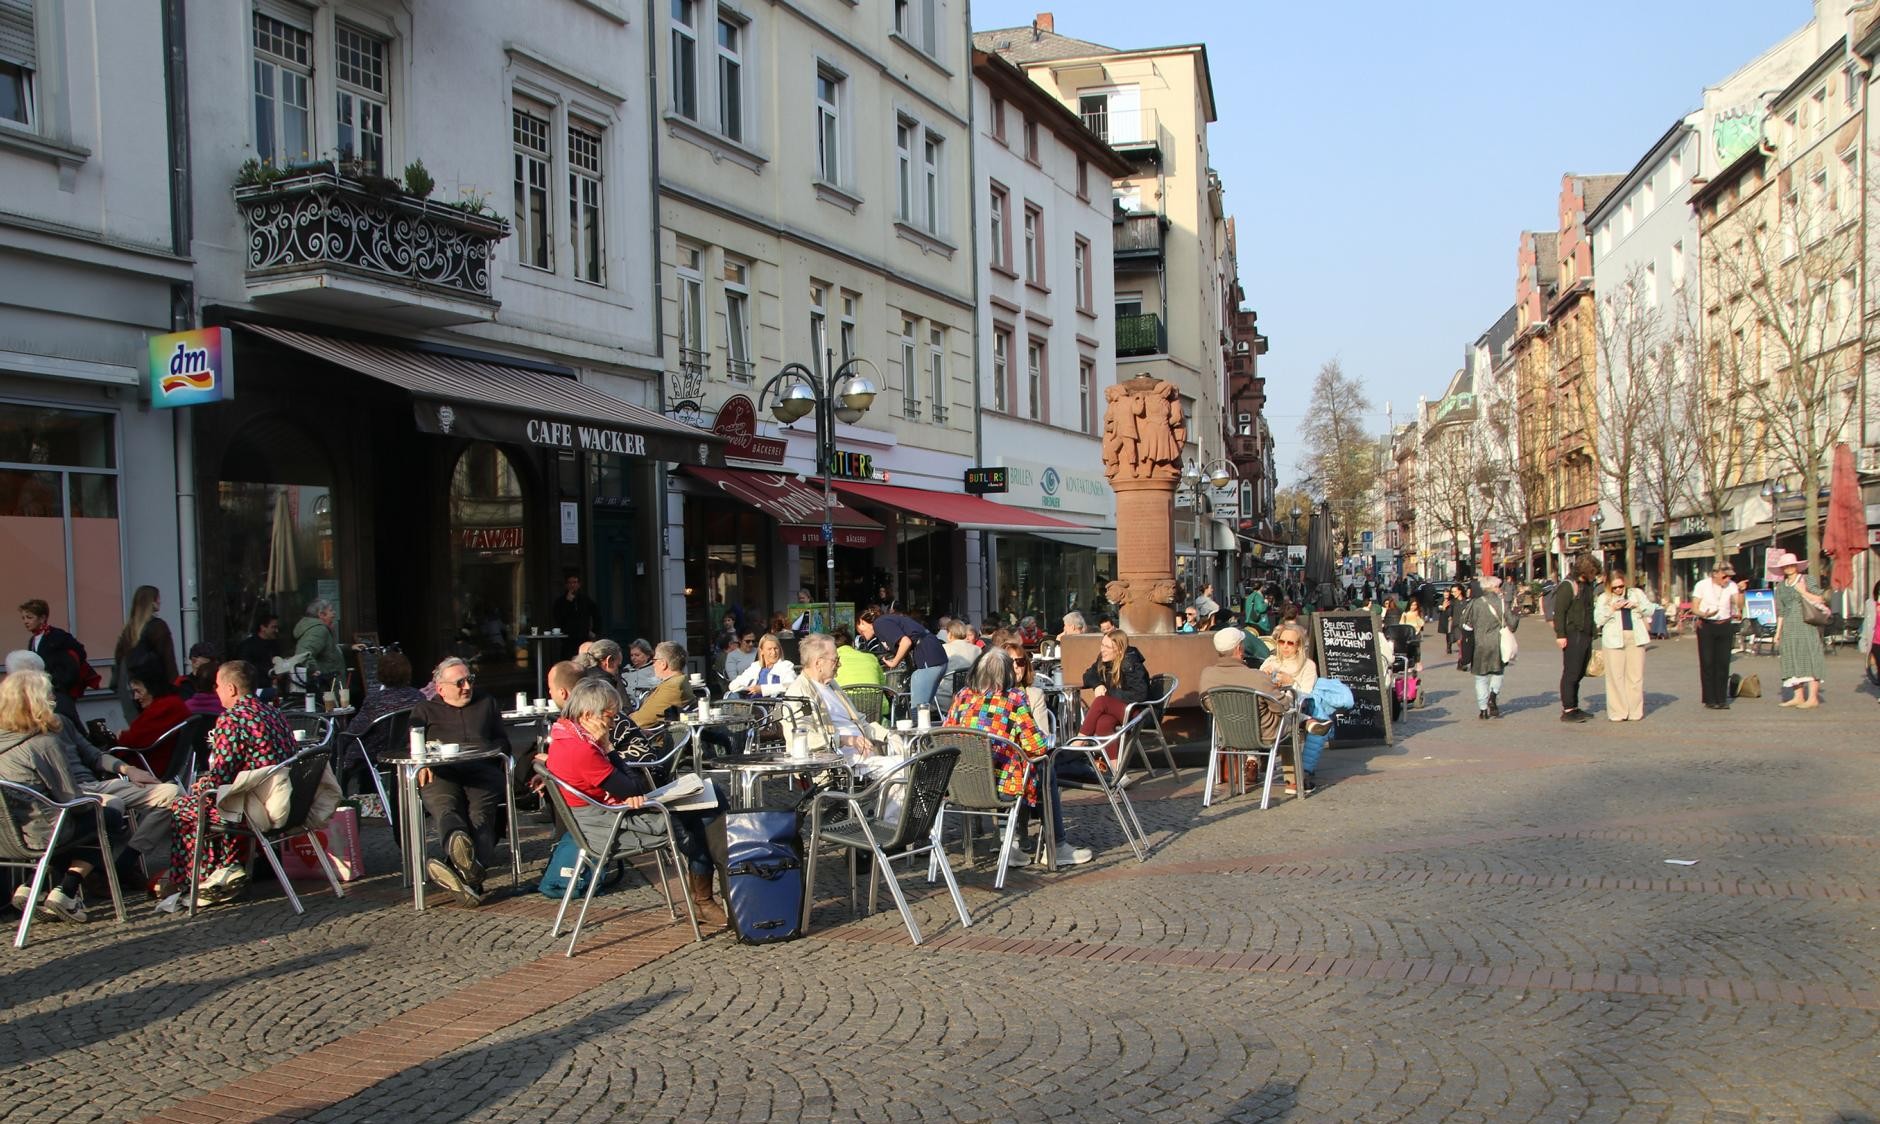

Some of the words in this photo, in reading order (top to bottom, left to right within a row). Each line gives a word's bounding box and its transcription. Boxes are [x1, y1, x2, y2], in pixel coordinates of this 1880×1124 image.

[170, 343, 206, 375] dm
[526, 419, 572, 446] CAFE
[577, 426, 646, 456] WACKER
[751, 442, 782, 456] BÄCKEREI
[831, 450, 873, 479] UTLERS
[969, 472, 1004, 483] BUTLERS
[1010, 467, 1033, 486] BRILLEN
[1323, 618, 1355, 631] BELEGTE
[1323, 628, 1357, 639] STULLEN
[1357, 631, 1373, 641] UND
